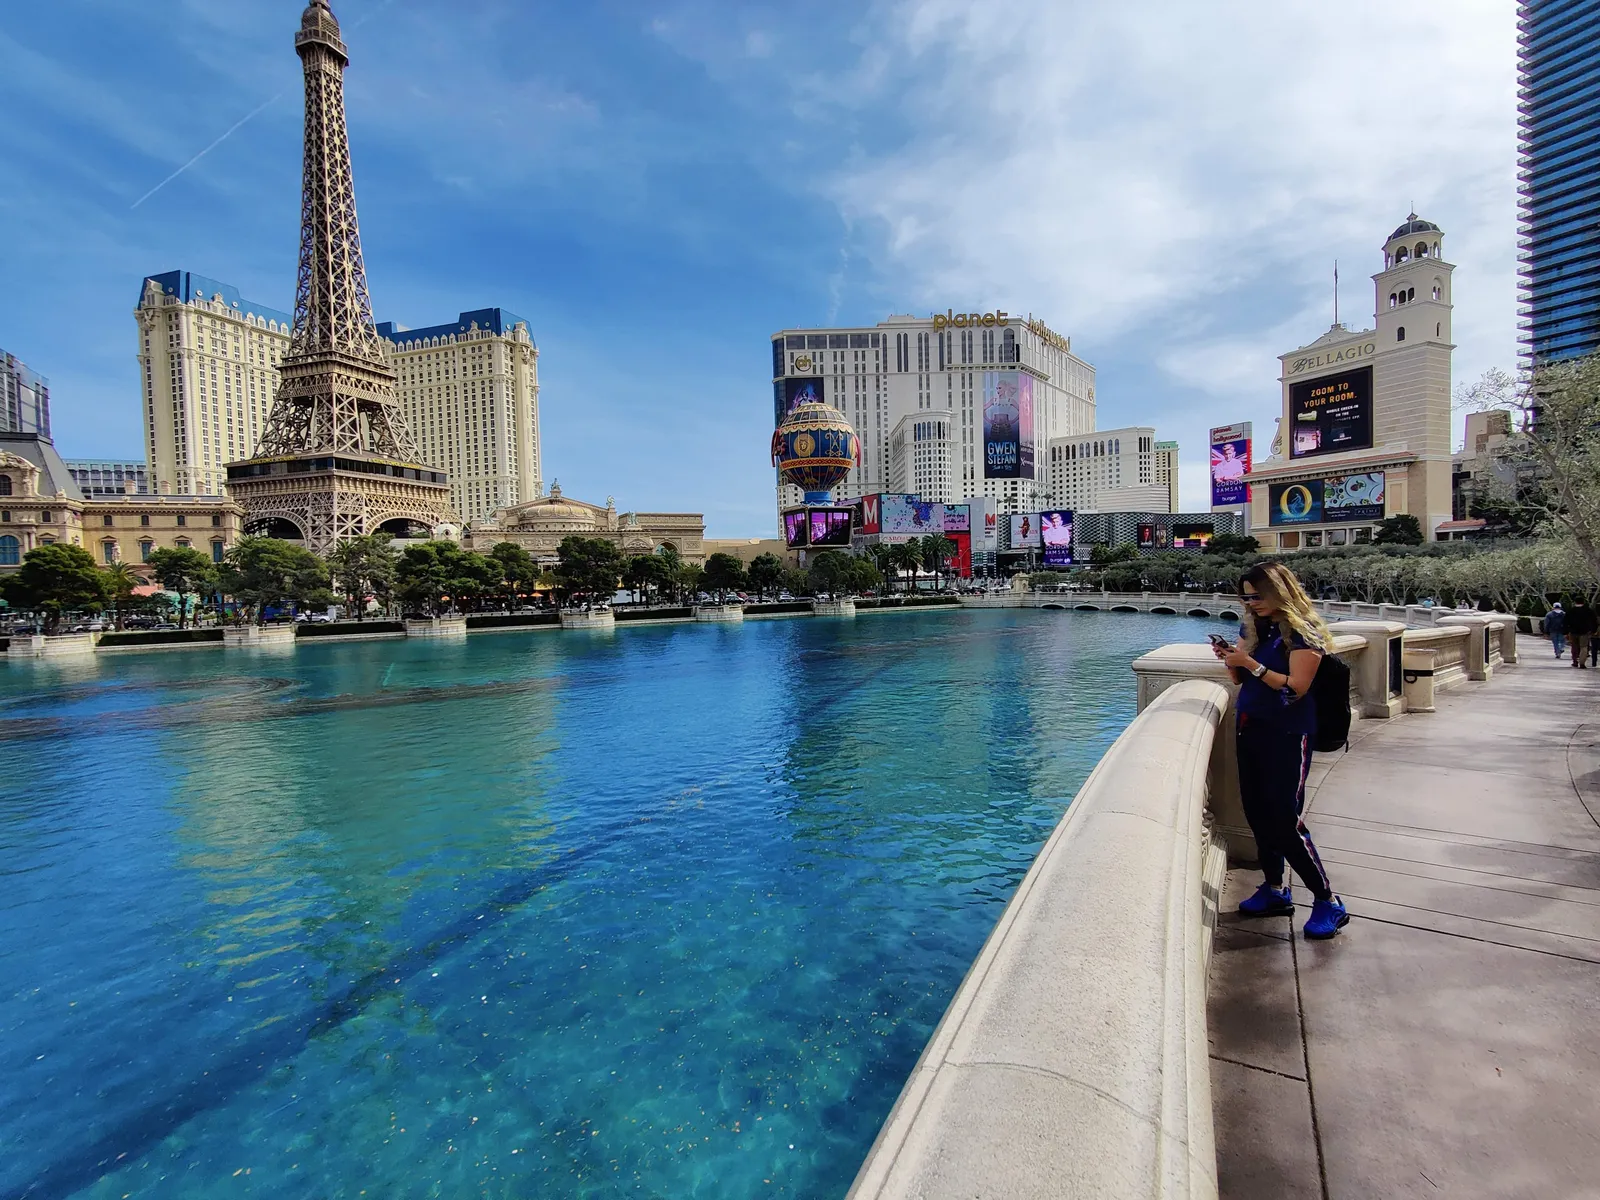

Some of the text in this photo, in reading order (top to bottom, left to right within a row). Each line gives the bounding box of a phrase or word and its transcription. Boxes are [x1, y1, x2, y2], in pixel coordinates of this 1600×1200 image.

[933, 308, 1008, 332] planet
[1288, 343, 1375, 374] BELLAGIO
[1311, 382, 1349, 397] ZOOM TO
[1304, 391, 1358, 408] YOUR ROOM.
[1213, 426, 1232, 436] planet
[1213, 432, 1242, 442] hollywood
[987, 441, 1016, 454] GWEN
[987, 454, 1017, 465] STEFANI
[1216, 480, 1243, 488] GORDON
[863, 499, 878, 526] M
[985, 513, 996, 526] M
